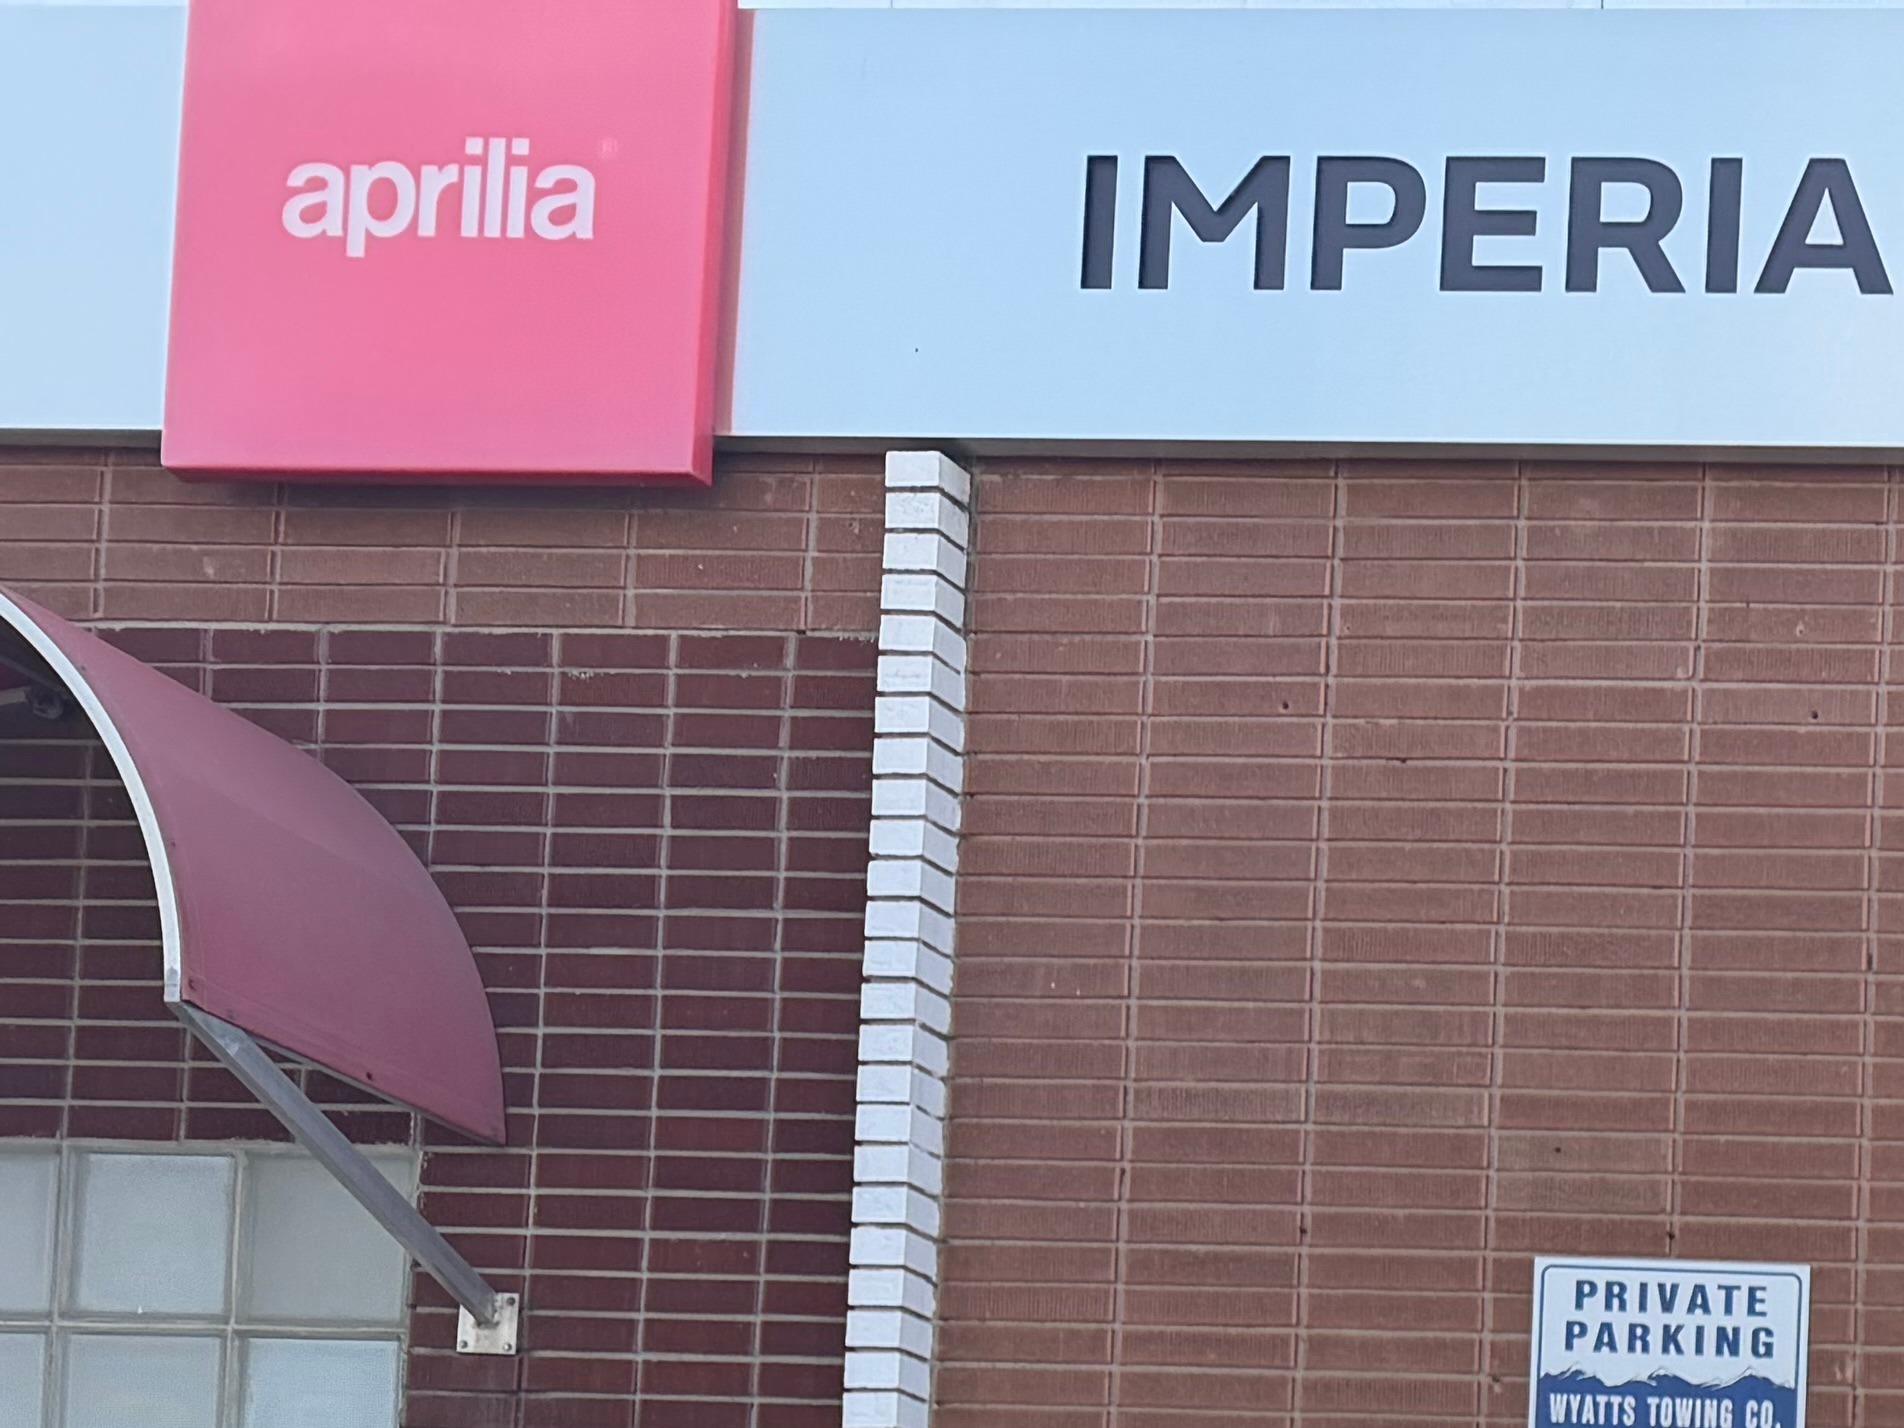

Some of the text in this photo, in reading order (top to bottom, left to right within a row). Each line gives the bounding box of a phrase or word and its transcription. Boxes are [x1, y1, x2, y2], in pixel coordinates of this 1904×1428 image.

[281, 137, 597, 258] aprilia
[1574, 1279, 1768, 1317] PRIVATE
[1564, 1320, 1775, 1359] PARKING
[1549, 1393, 1636, 1427] WYATTS
